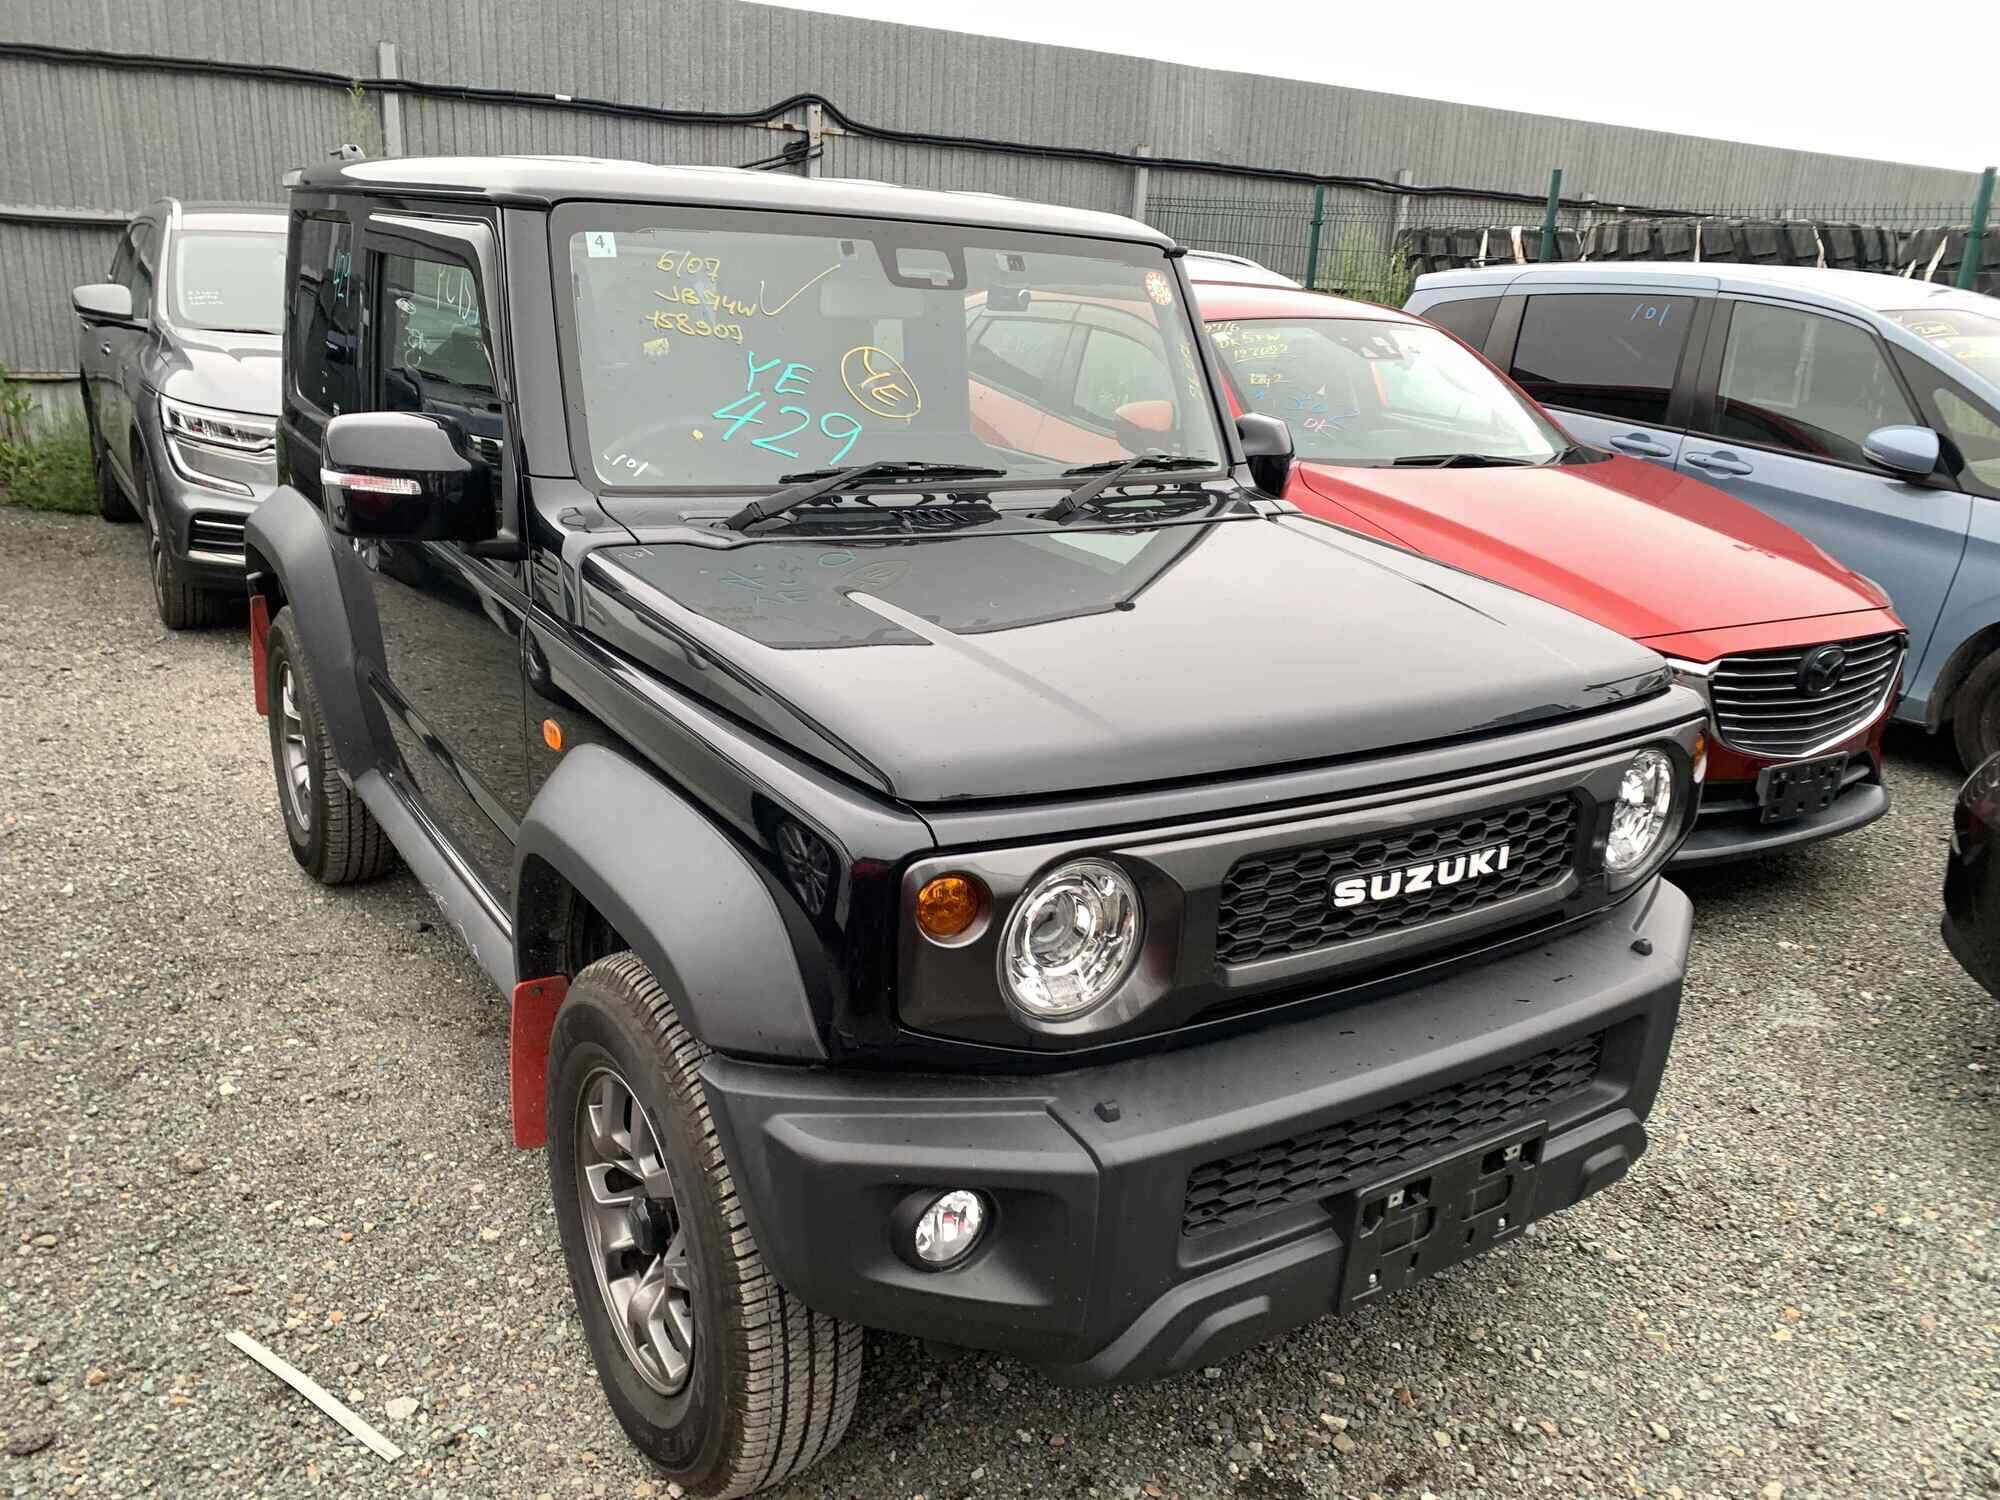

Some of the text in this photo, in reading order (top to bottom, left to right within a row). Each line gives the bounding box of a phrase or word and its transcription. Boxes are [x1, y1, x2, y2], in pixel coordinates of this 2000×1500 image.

[594, 234, 605, 249] 4
[746, 351, 817, 396] YE
[711, 391, 864, 466] 429
[1333, 845, 1510, 908] SUZUKI
